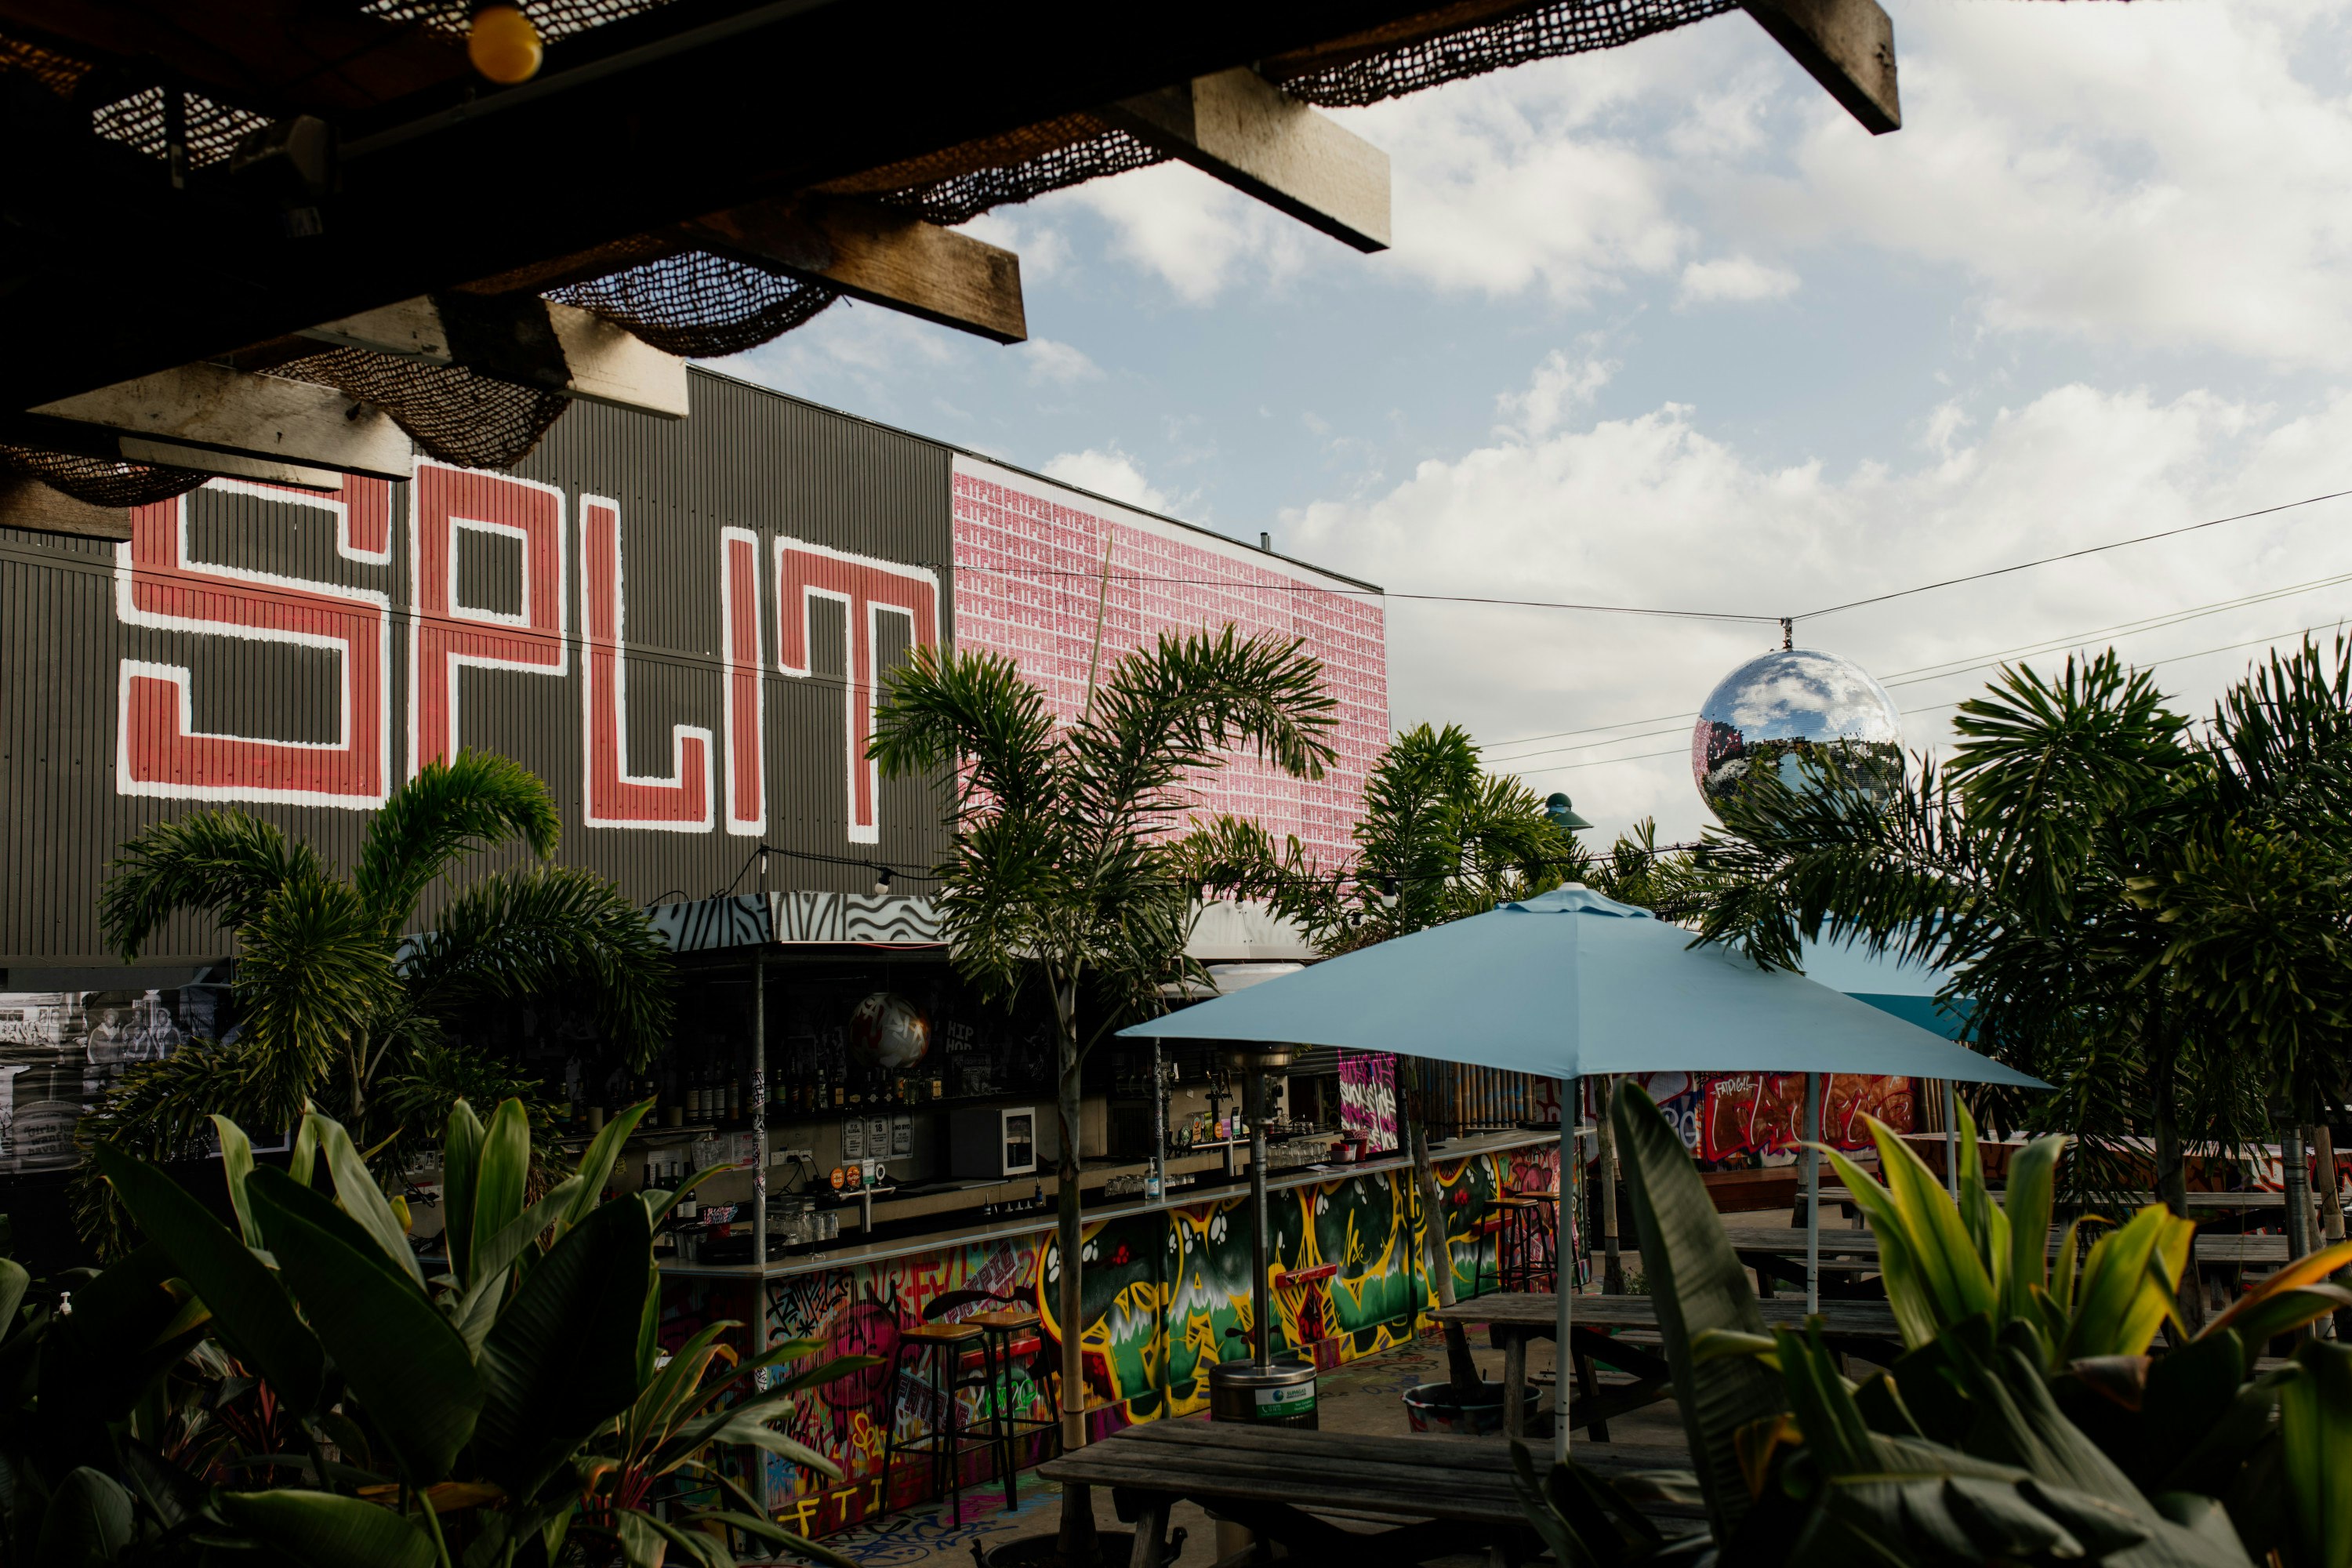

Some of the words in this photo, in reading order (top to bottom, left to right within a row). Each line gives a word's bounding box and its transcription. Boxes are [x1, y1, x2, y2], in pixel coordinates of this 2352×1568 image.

[953, 470, 1002, 506] FATPIG
[1004, 487, 1051, 521] FATPIG
[1052, 503, 1096, 535] FATPIG
[1098, 517, 1139, 548] FATPIG
[1141, 530, 1179, 560] FATPIG
[1180, 542, 1218, 571] FATPIG
[1218, 554, 1254, 582] FATPIG
[1255, 565, 1289, 593] FATPIG
[1290, 578, 1322, 604] FATPIG
[1323, 590, 1353, 615] FATPIG
[1354, 600, 1383, 624] FATPIG
[953, 494, 1002, 528] FATPIG
[1004, 510, 1051, 543] FATPIG
[1052, 524, 1097, 556] FATPIG
[1098, 538, 1140, 568] FATPIG
[1142, 550, 1180, 580] FATPIG
[1181, 562, 1218, 590] FATPIG
[1219, 574, 1255, 601] FATPIG
[1256, 585, 1290, 611] FATPIG
[1290, 597, 1323, 622] FATPIG
[1323, 608, 1354, 632] FATPIG
[1355, 617, 1384, 641] FATPIG
[953, 517, 1003, 551] FATPIG
[1004, 532, 1051, 564] FATPIG
[1053, 546, 1098, 578] FATPIG
[1099, 559, 1141, 590] FATPIG
[1142, 572, 1181, 600] FATPIG
[1181, 583, 1219, 610] FATPIG
[1220, 593, 1256, 620] FATPIG
[1257, 604, 1290, 630] FATPIG
[1291, 615, 1323, 640] FATPIG
[1324, 626, 1355, 650] FATPIG
[1356, 635, 1385, 658] FATPIG
[954, 541, 1004, 574] FATPIG
[1005, 555, 1052, 587] FATPIG
[1054, 568, 1098, 599] FATPIG
[1143, 592, 1181, 620] FATPIG
[1182, 602, 1220, 630] FATPIG
[1325, 644, 1356, 667] FATPIG
[1356, 652, 1385, 675] FATPIG
[955, 564, 1004, 597] FATPIG
[1006, 578, 1053, 609] FATPIG
[1054, 590, 1099, 620] FATPIG
[1326, 662, 1357, 685] FATPIG
[1357, 670, 1386, 692] FATPIG
[117, 455, 940, 844] SPLIT
[955, 588, 1004, 620] FATPIG
[1007, 601, 1054, 631] FATPIG
[1055, 612, 1100, 642] FATPIG
[1102, 623, 1143, 652] FATPIG
[1327, 681, 1358, 703] FATPIG
[1358, 688, 1387, 710] FATPIG
[956, 612, 1005, 644] FATPIG
[1007, 623, 1054, 653] FATPIG
[1359, 706, 1388, 728] FATPIG
[1330, 735, 1360, 757] FATPIG
[1360, 724, 1389, 745] FATPIG
[1330, 753, 1361, 775] ATPIG
[1331, 772, 1362, 793] FATPIG
[1189, 766, 1227, 789] FATPIG
[1228, 771, 1264, 794] FATPIG
[1265, 778, 1298, 799] FATPIG
[1299, 784, 1331, 804] FATPIG
[1332, 790, 1363, 811] FATPIG
[1229, 792, 1265, 814] FATPIG
[1265, 797, 1299, 818] FATPIG
[1300, 803, 1332, 823] FATPIG
[1266, 816, 1300, 837] FATPIG
[1301, 822, 1333, 842] FATPIG
[947, 1020, 974, 1041] HIP
[59, 1123, 76, 1134] jus
[27, 1145, 56, 1156] have
